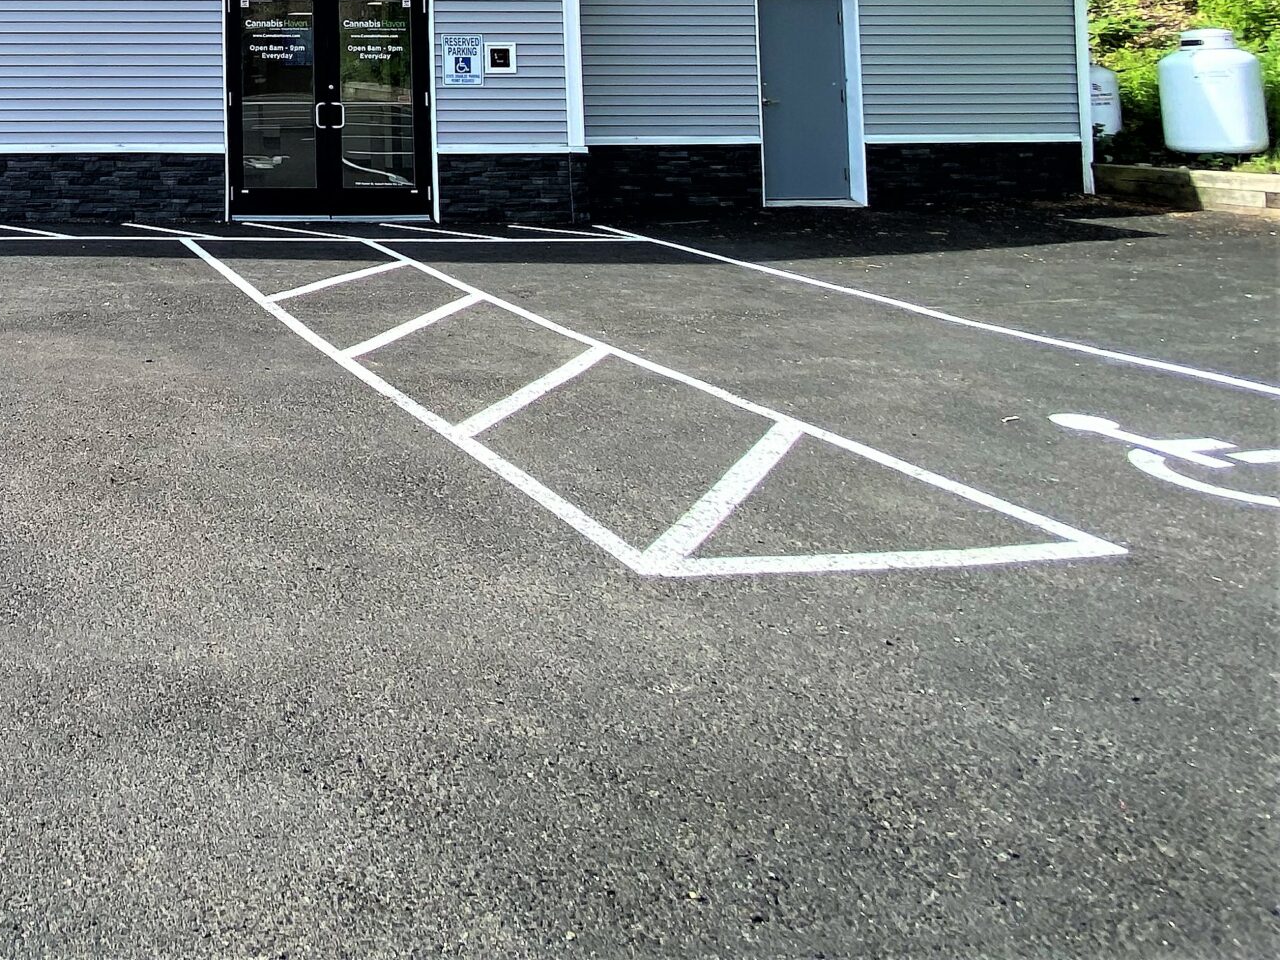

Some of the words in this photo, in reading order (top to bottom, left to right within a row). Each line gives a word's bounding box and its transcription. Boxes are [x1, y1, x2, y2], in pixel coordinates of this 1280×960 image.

[245, 19, 283, 27] Cannabis
[343, 19, 380, 28] Cannabis
[381, 20, 406, 28] Haven
[444, 37, 480, 46] RESERVED
[448, 47, 477, 56] PARKING
